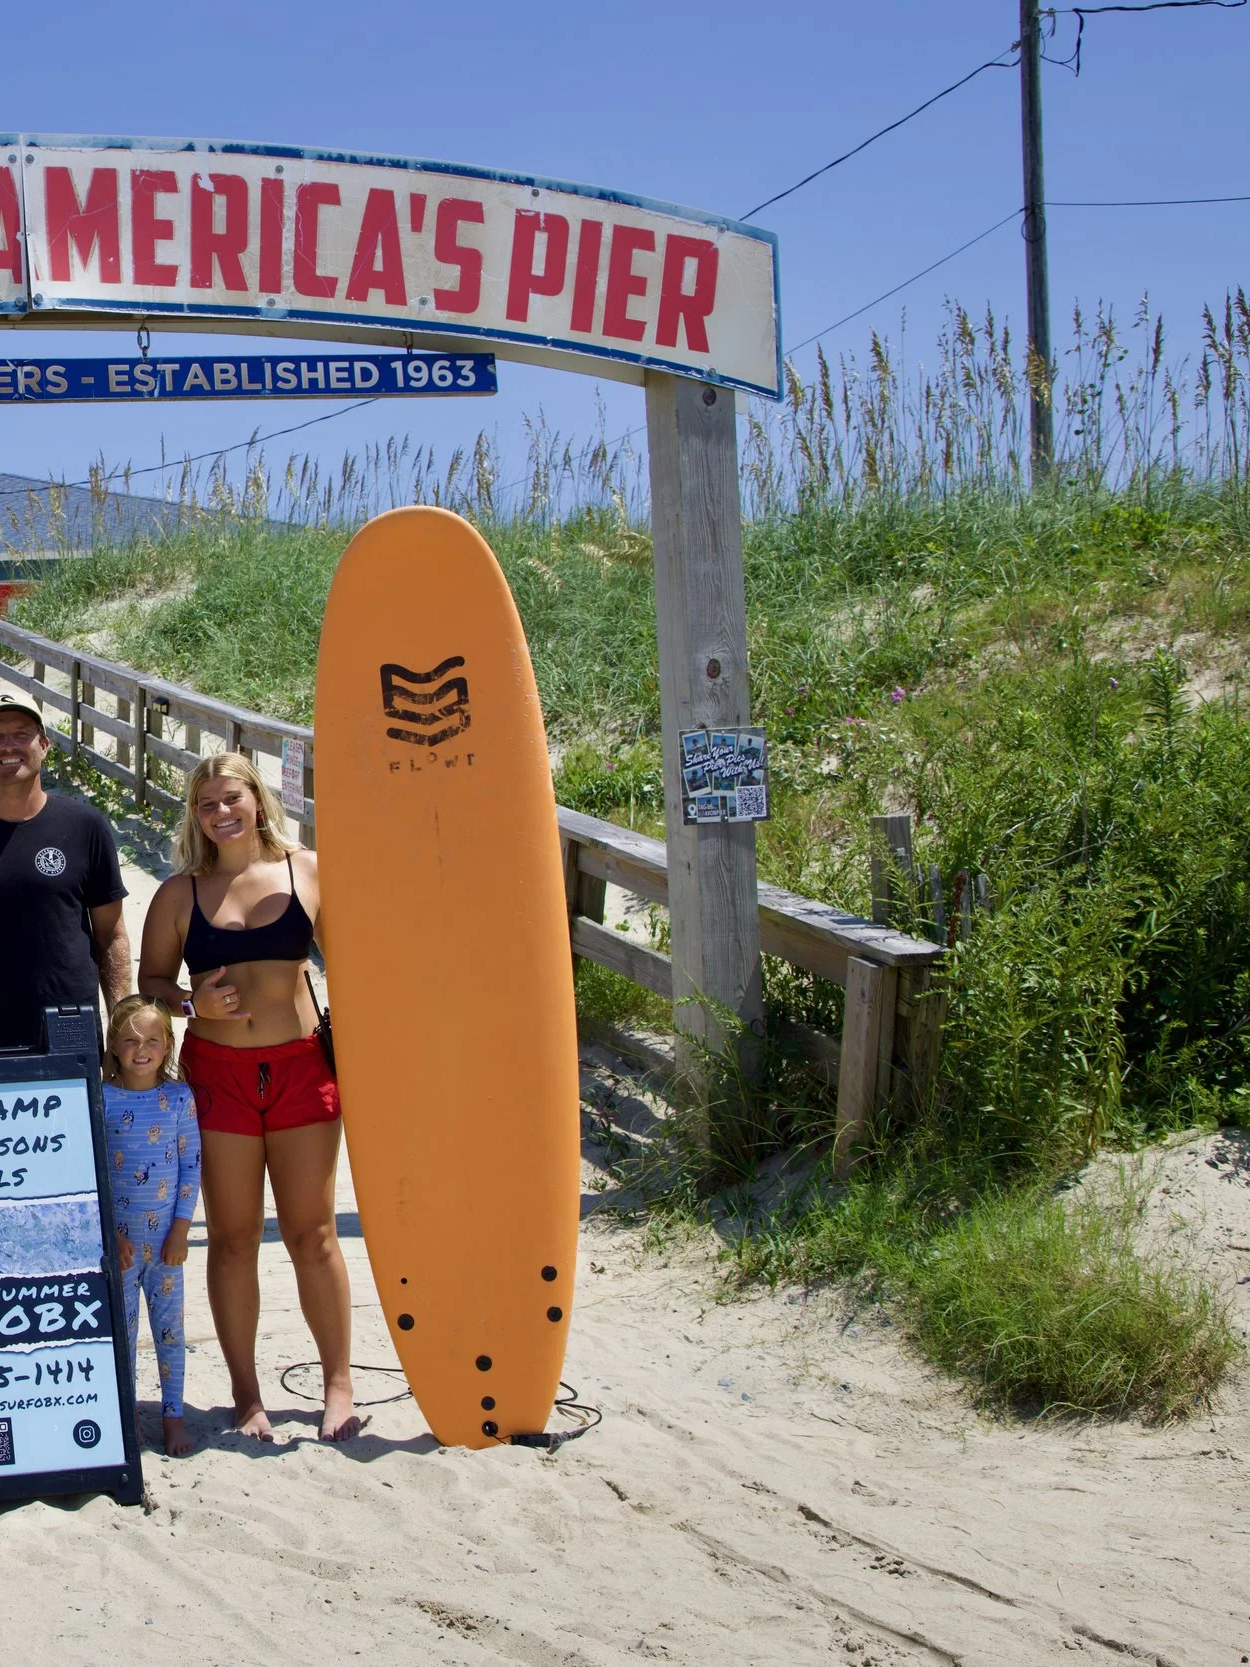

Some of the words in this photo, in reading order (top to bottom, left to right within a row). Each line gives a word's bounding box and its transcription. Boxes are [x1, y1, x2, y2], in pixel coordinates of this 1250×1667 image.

[506, 208, 720, 355] PIER
[108, 360, 380, 393] ESTABLISHED
[390, 359, 476, 389] 1963
[685, 751, 711, 767] Share
[710, 745, 734, 759] Your
[702, 760, 726, 774] Pier
[725, 754, 746, 765] Pics
[720, 765, 743, 778] With
[746, 756, 764, 770] Us!
